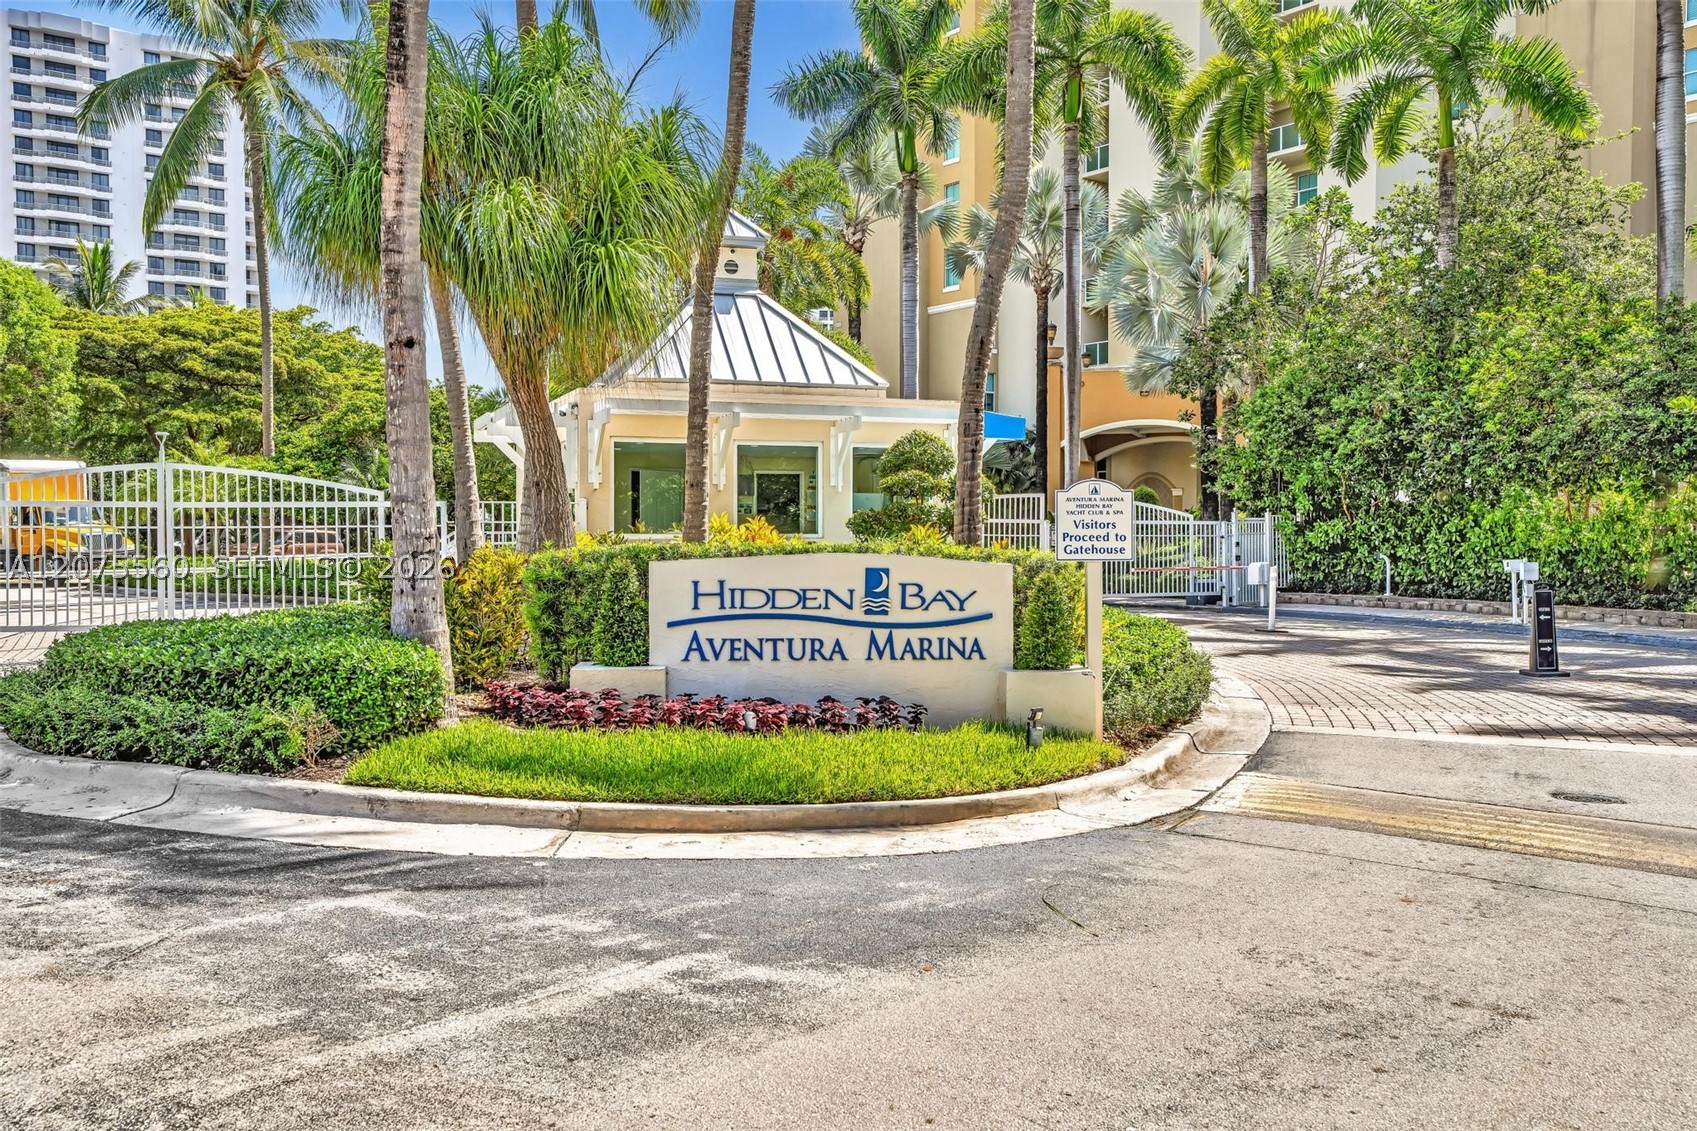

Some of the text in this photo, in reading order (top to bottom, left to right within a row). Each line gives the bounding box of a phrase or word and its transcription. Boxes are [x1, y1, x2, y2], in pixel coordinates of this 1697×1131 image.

[1073, 519, 1117, 530] Visitors
[1062, 532, 1127, 542] Proceed to
[1063, 544, 1126, 555] Gatehouse
[691, 579, 977, 612] HIDDEN BAY
[681, 629, 987, 662] AVENTURA MARINA
